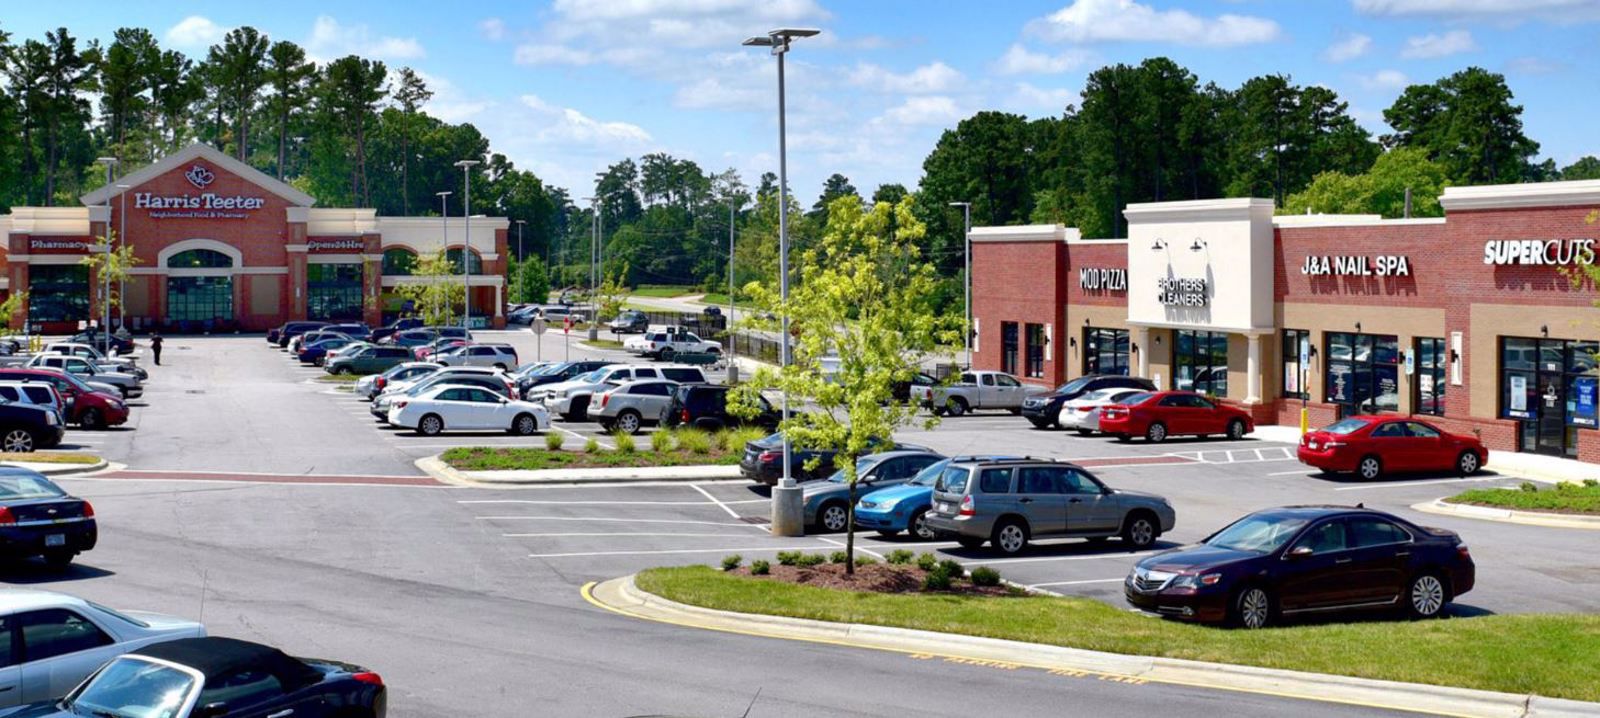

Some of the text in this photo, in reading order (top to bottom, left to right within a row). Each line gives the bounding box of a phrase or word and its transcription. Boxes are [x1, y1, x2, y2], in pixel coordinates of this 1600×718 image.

[134, 192, 264, 209] Harris Teeter
[31, 240, 87, 250] Pharmacy
[1484, 239, 1595, 265] SUPERCUTS
[1301, 255, 1409, 276] J&A NAIL SPA
[1080, 268, 1127, 291] MOD PIZZA
[1157, 278, 1204, 292] BROTHERS
[1157, 293, 1205, 307] CLEANERS
